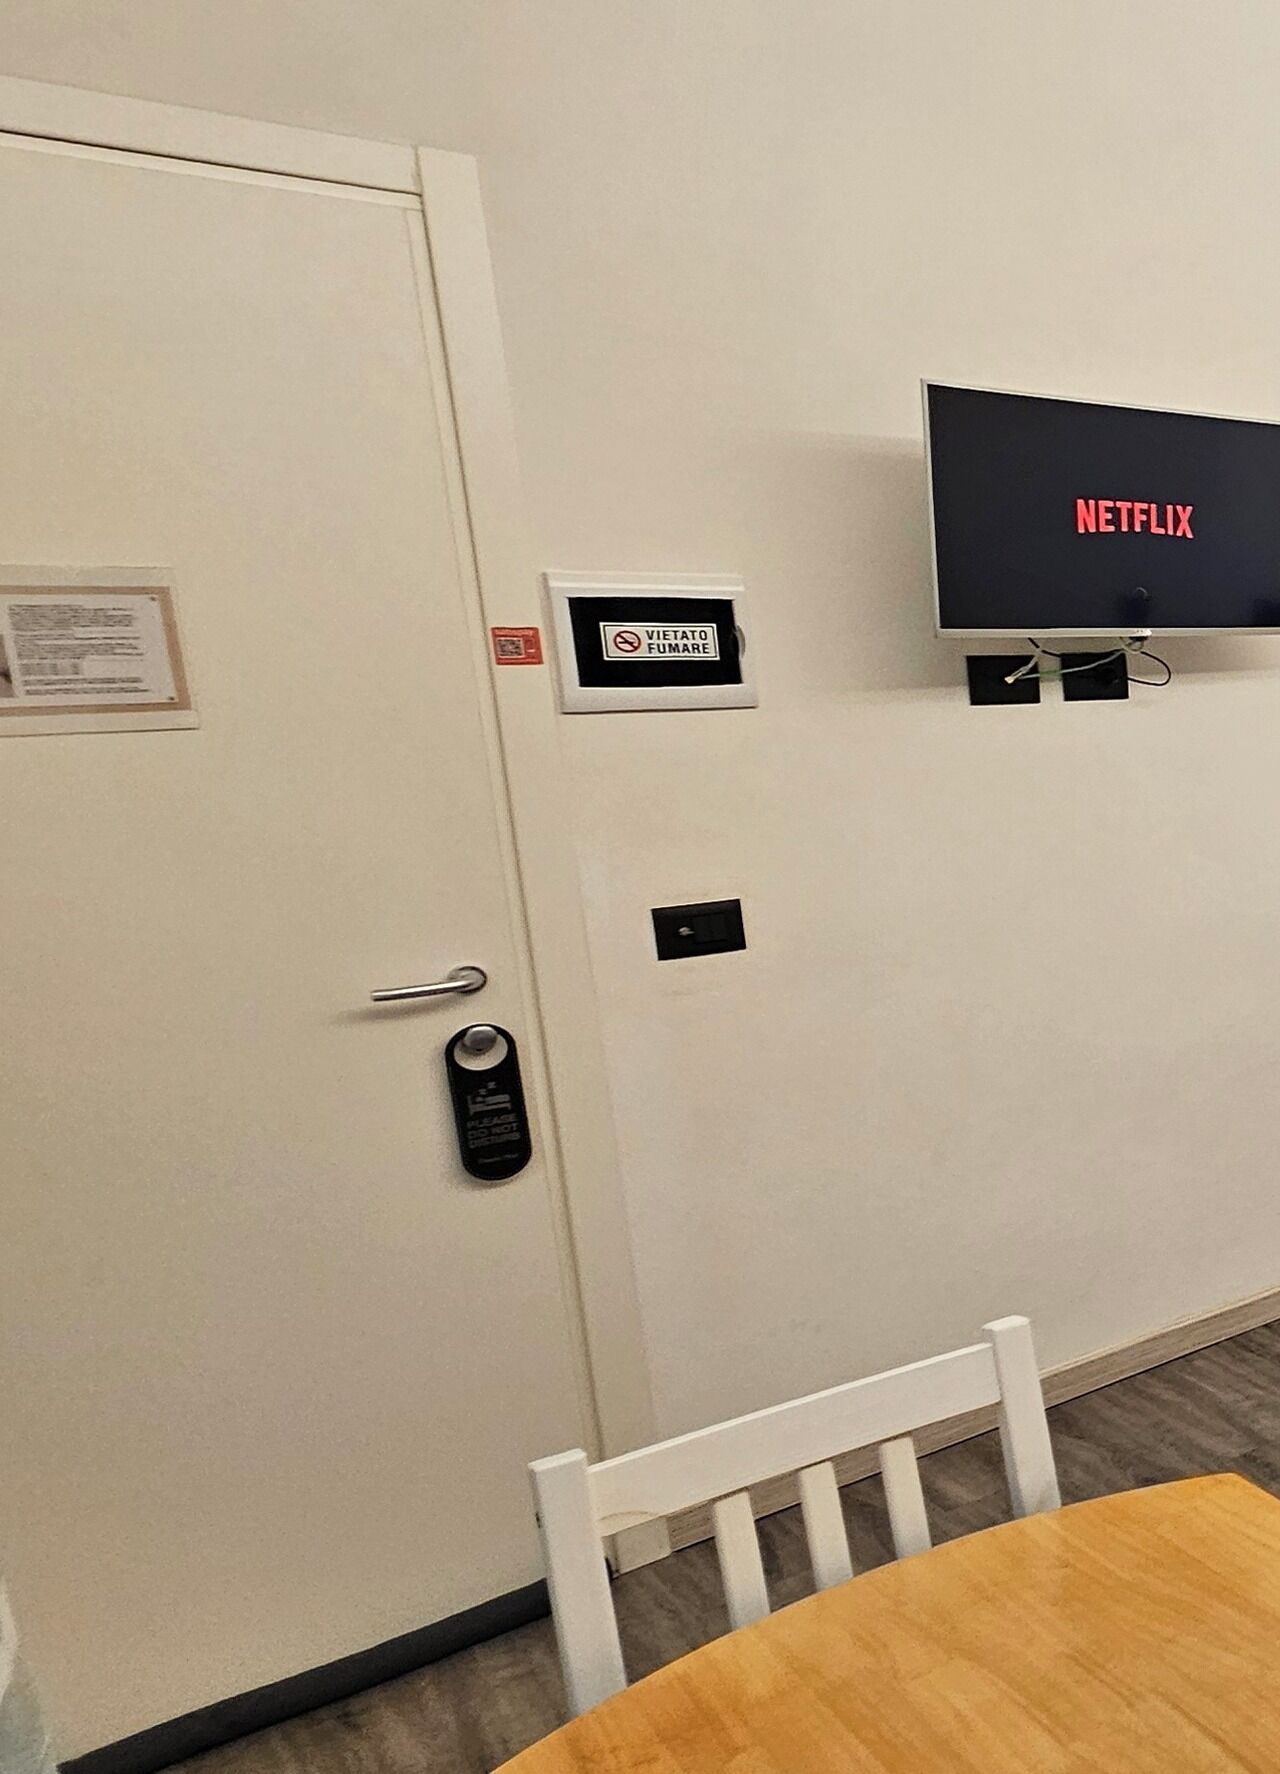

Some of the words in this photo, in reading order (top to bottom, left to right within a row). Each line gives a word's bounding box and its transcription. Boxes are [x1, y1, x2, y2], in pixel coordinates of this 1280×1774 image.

[1075, 498, 1195, 539] NETFLIX
[645, 629, 708, 642] VIETATO
[647, 643, 710, 655] FUMARE
[466, 1113, 520, 1129] PLEASE
[467, 1128, 489, 1139] DO
[491, 1123, 519, 1135] NOT
